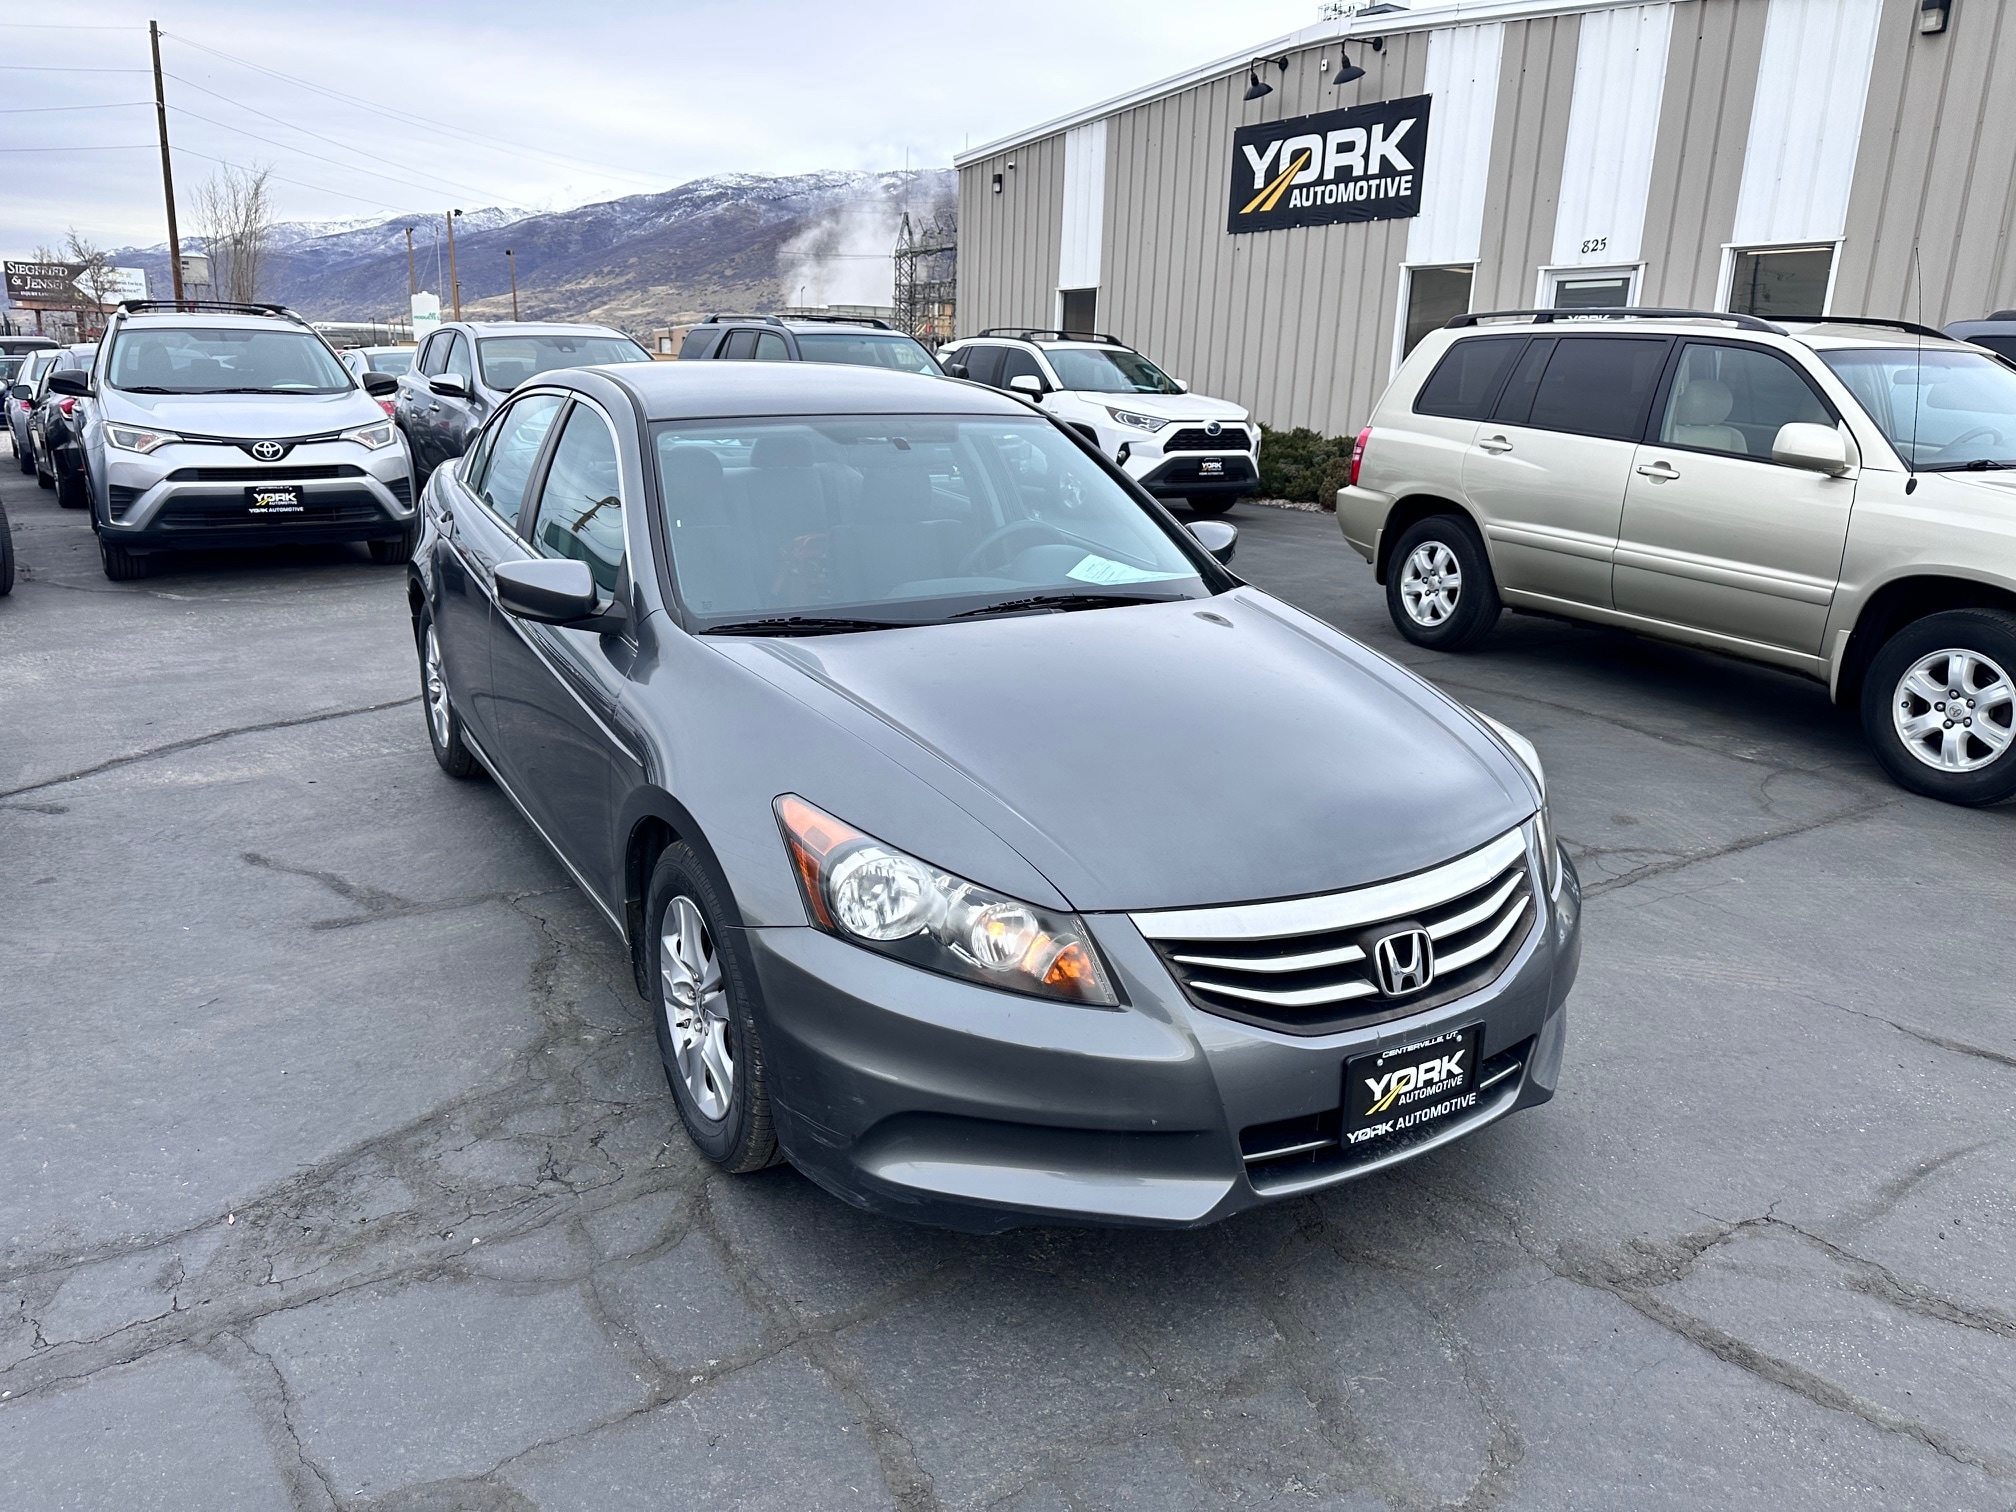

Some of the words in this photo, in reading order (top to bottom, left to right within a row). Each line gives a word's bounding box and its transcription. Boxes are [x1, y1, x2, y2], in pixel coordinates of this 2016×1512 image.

[1241, 117, 1417, 190] YORK
[1288, 174, 1413, 209] AUTOMOTIVE
[1581, 237, 1607, 254] 825
[7, 261, 68, 276] SIEGFRIED
[11, 275, 23, 285] &
[253, 493, 297, 502] YORK
[1381, 1034, 1444, 1059] CENTERVILLE,
[1445, 1031, 1459, 1040] UT
[1364, 1049, 1466, 1102] YORK
[1398, 1074, 1464, 1106] AUTOMOTIVE
[1346, 1119, 1395, 1144] YORK
[1395, 1092, 1477, 1131] AUTOMOTIVE
